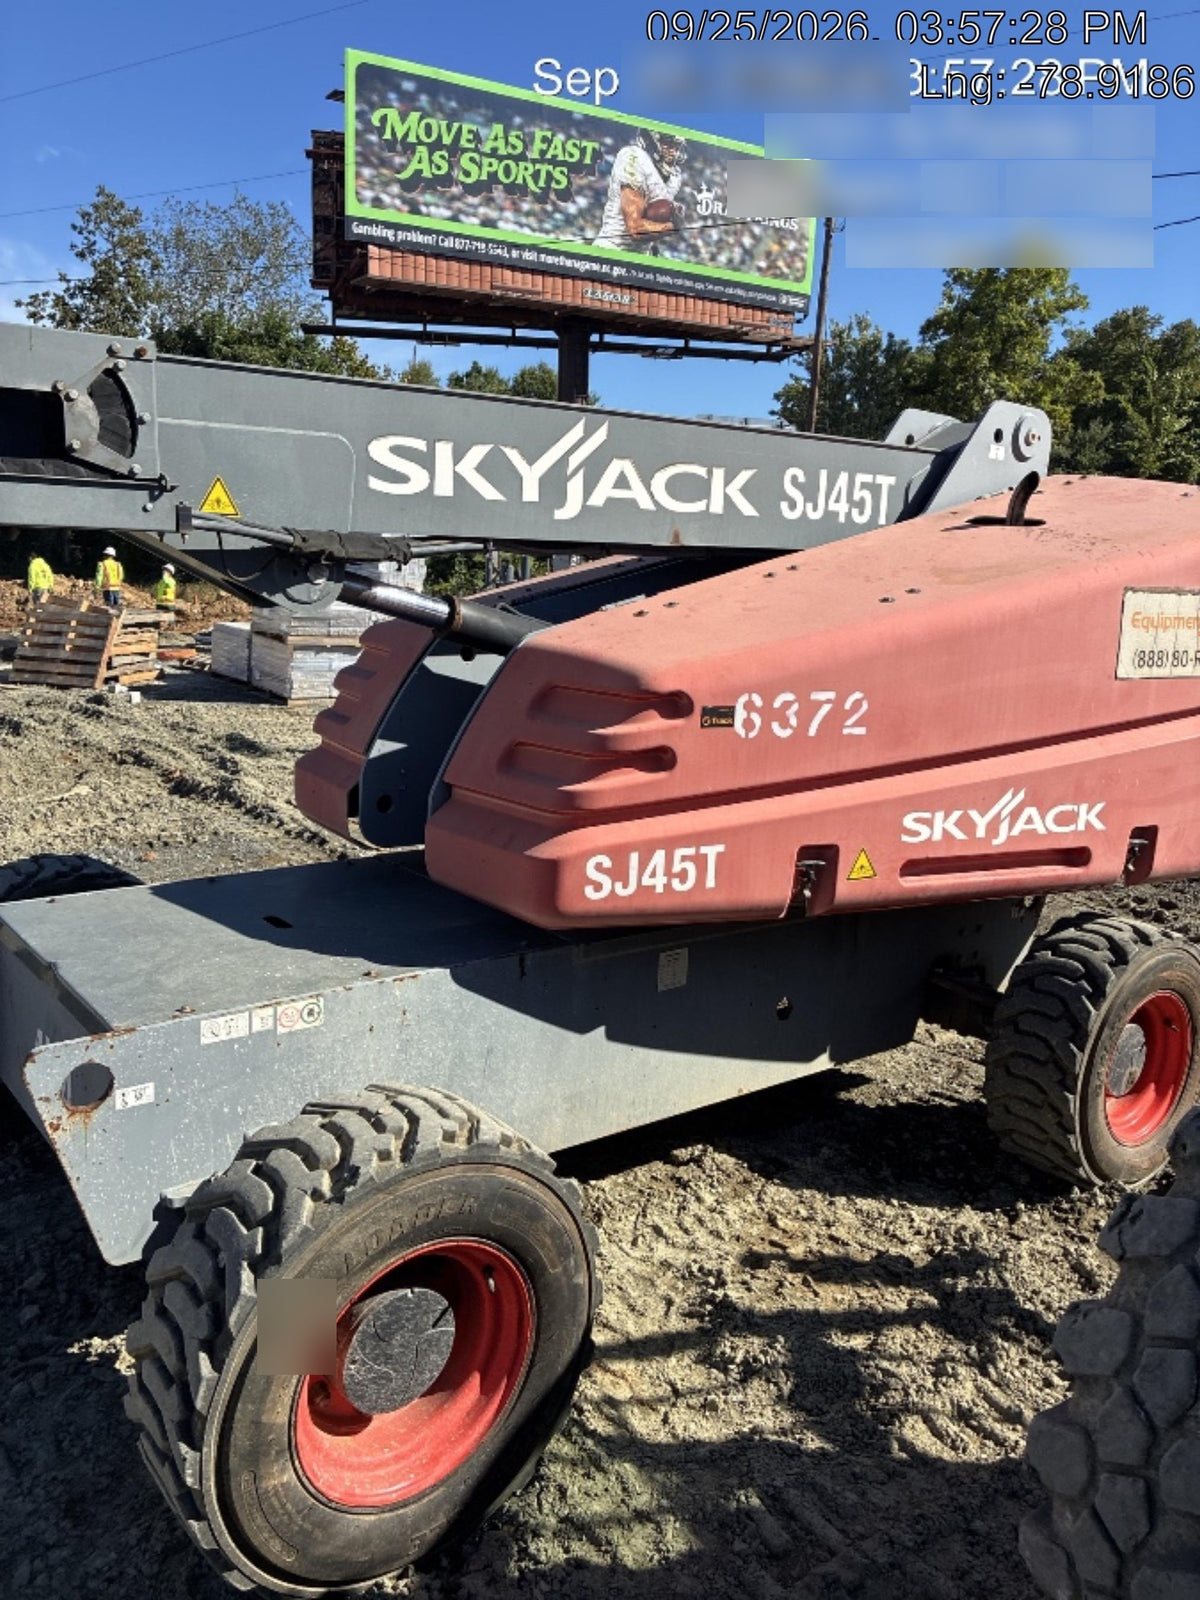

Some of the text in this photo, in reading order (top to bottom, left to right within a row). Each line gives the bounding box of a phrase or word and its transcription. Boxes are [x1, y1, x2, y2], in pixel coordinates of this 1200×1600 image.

[371, 108, 600, 164] MOVE AS FAST
[395, 146, 569, 193] AS SPORTS
[351, 221, 395, 242] Gambling
[396, 230, 437, 247] problem?
[438, 235, 454, 248] Call
[367, 417, 897, 525] SKYJACK SJ45T
[1133, 648, 1169, 669] (888)
[734, 691, 869, 738] 6372
[901, 788, 1106, 845] SKYJACK
[583, 843, 725, 900] SJ45T
